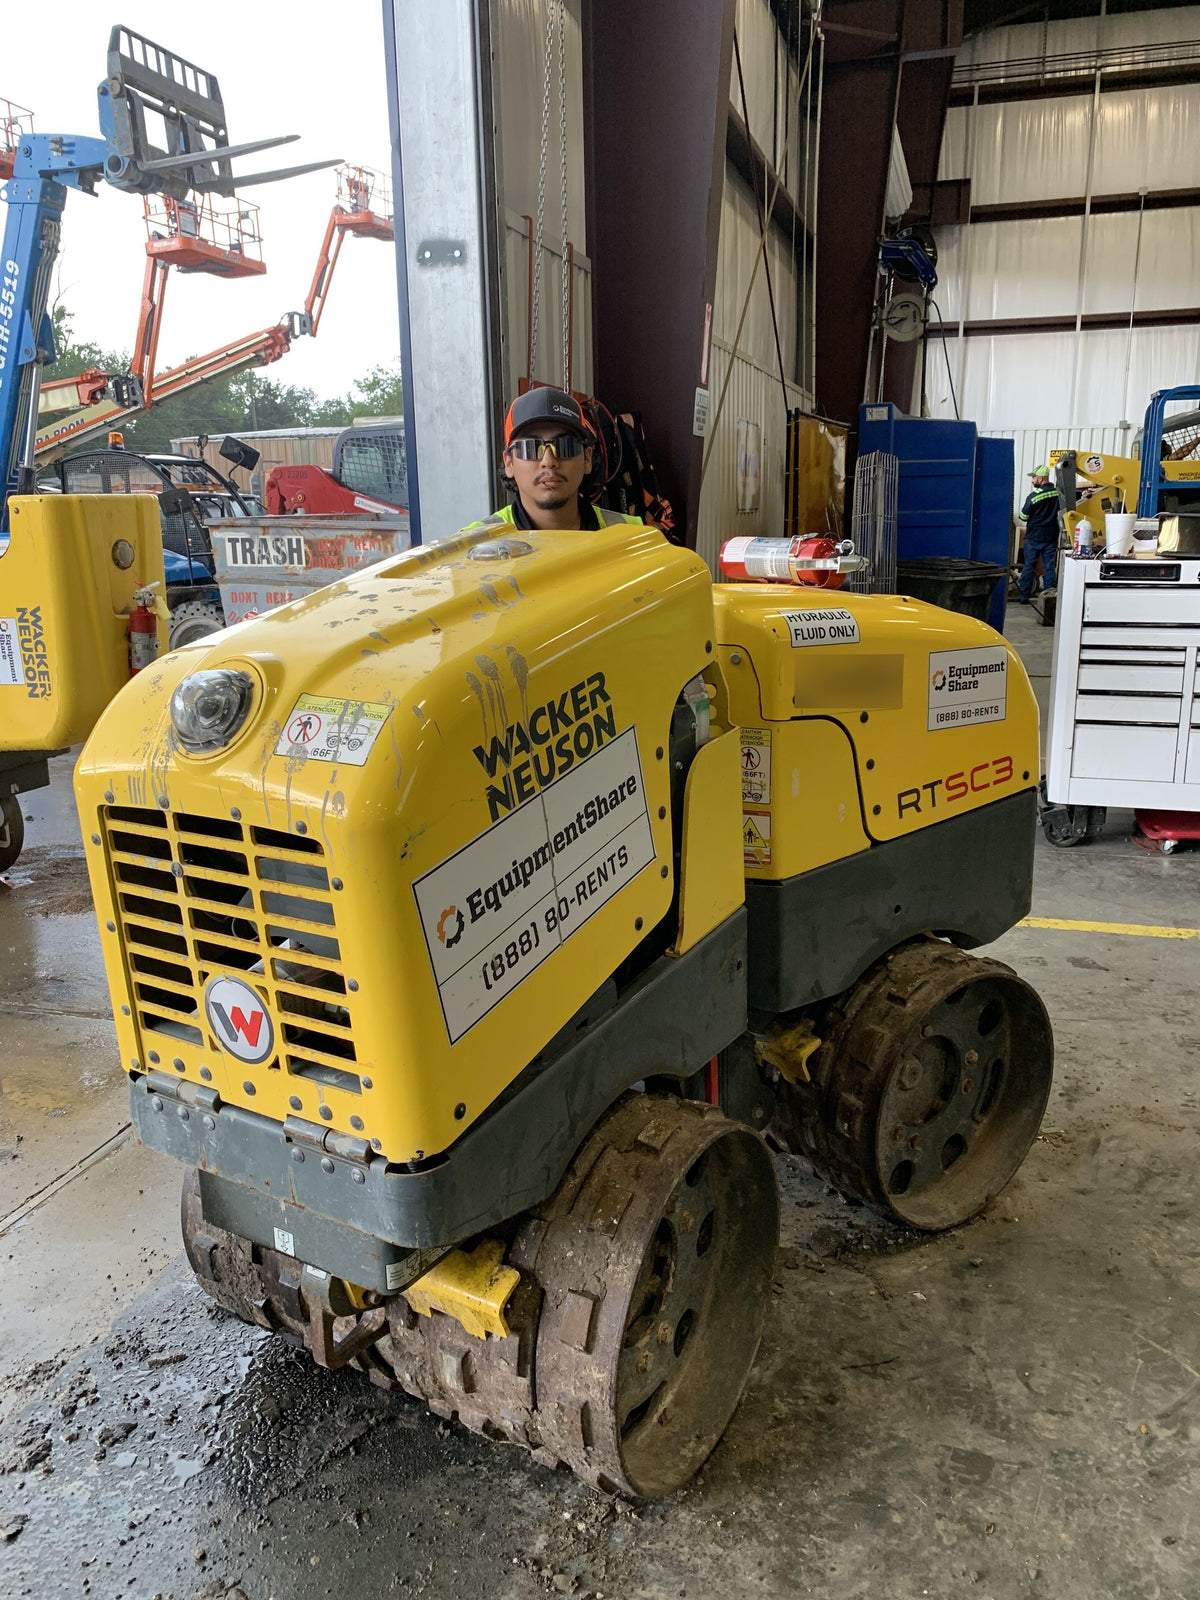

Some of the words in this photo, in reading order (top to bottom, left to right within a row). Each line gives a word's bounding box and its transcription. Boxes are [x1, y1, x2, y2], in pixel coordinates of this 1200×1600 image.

[227, 537, 304, 566] TRASH
[353, 537, 383, 551] RENT
[230, 591, 258, 605] DONT
[786, 610, 851, 623] HYDRAULIC
[794, 626, 826, 641] FLUID
[829, 625, 856, 638] ONLY
[6, 633, 18, 683] Equipment
[16, 607, 40, 698] NEUSON
[29, 605, 52, 699] WACKER
[948, 660, 1005, 679] Equipment
[948, 680, 979, 692] Share
[349, 709, 384, 720] ANTION
[473, 671, 612, 779] WACKER
[936, 710, 959, 723] (888)
[961, 705, 999, 719] 80-RENTS
[485, 704, 617, 824] NEUSON
[466, 775, 637, 924] EquipmentShare
[482, 921, 540, 990] (888)
[544, 845, 629, 933] 80-RENTS
